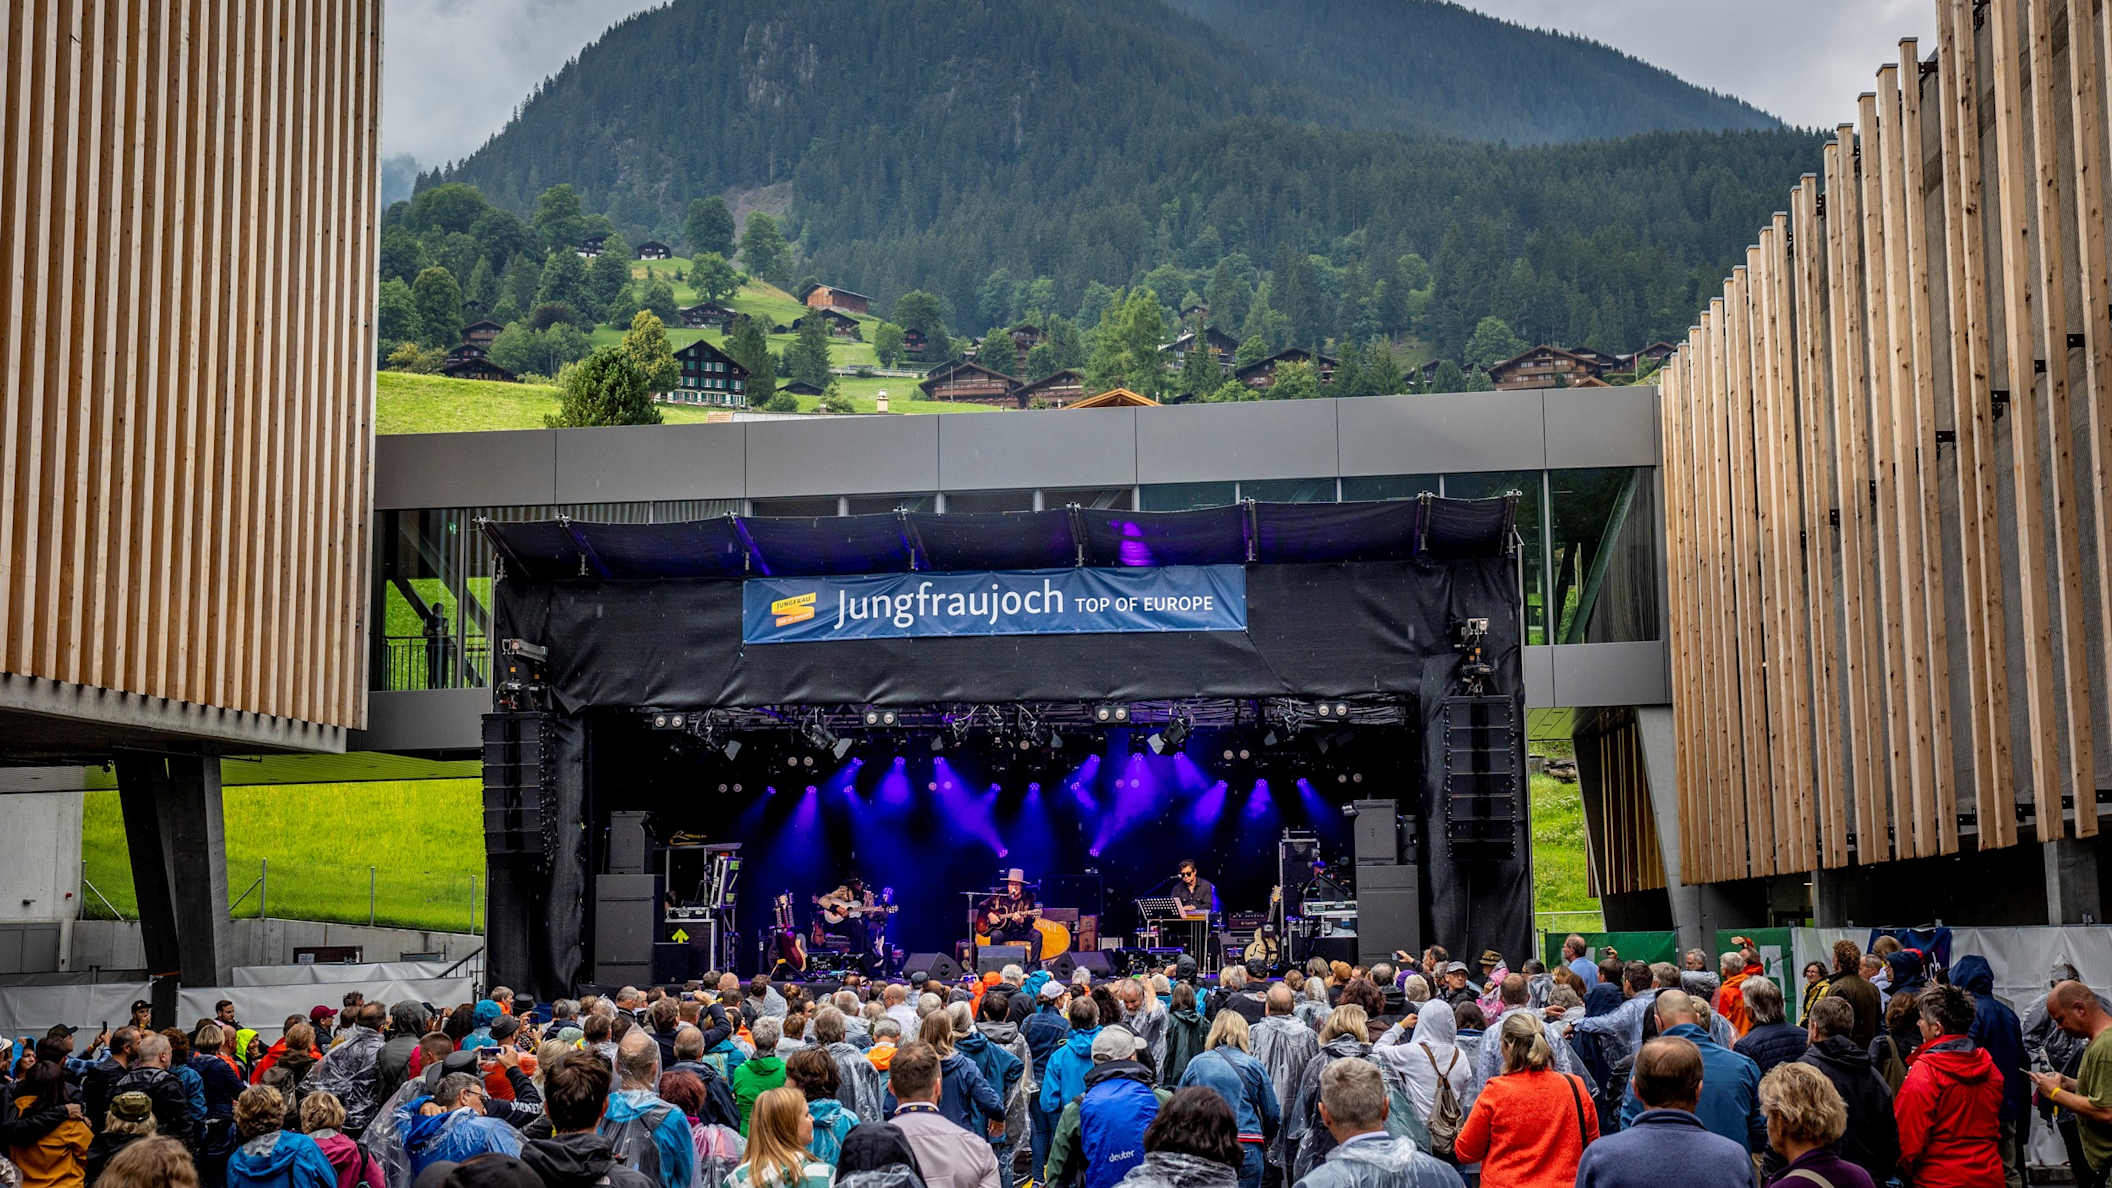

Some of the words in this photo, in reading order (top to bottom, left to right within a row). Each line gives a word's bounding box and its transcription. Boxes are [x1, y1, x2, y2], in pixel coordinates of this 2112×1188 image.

[776, 595, 811, 609] JUNGFRAU
[833, 578, 1064, 630] Jungfraujoch
[1074, 597, 1110, 613] TOP
[1115, 597, 1138, 612] OF
[1143, 596, 1214, 612] EUROPE
[1108, 1150, 1135, 1162] deuter
